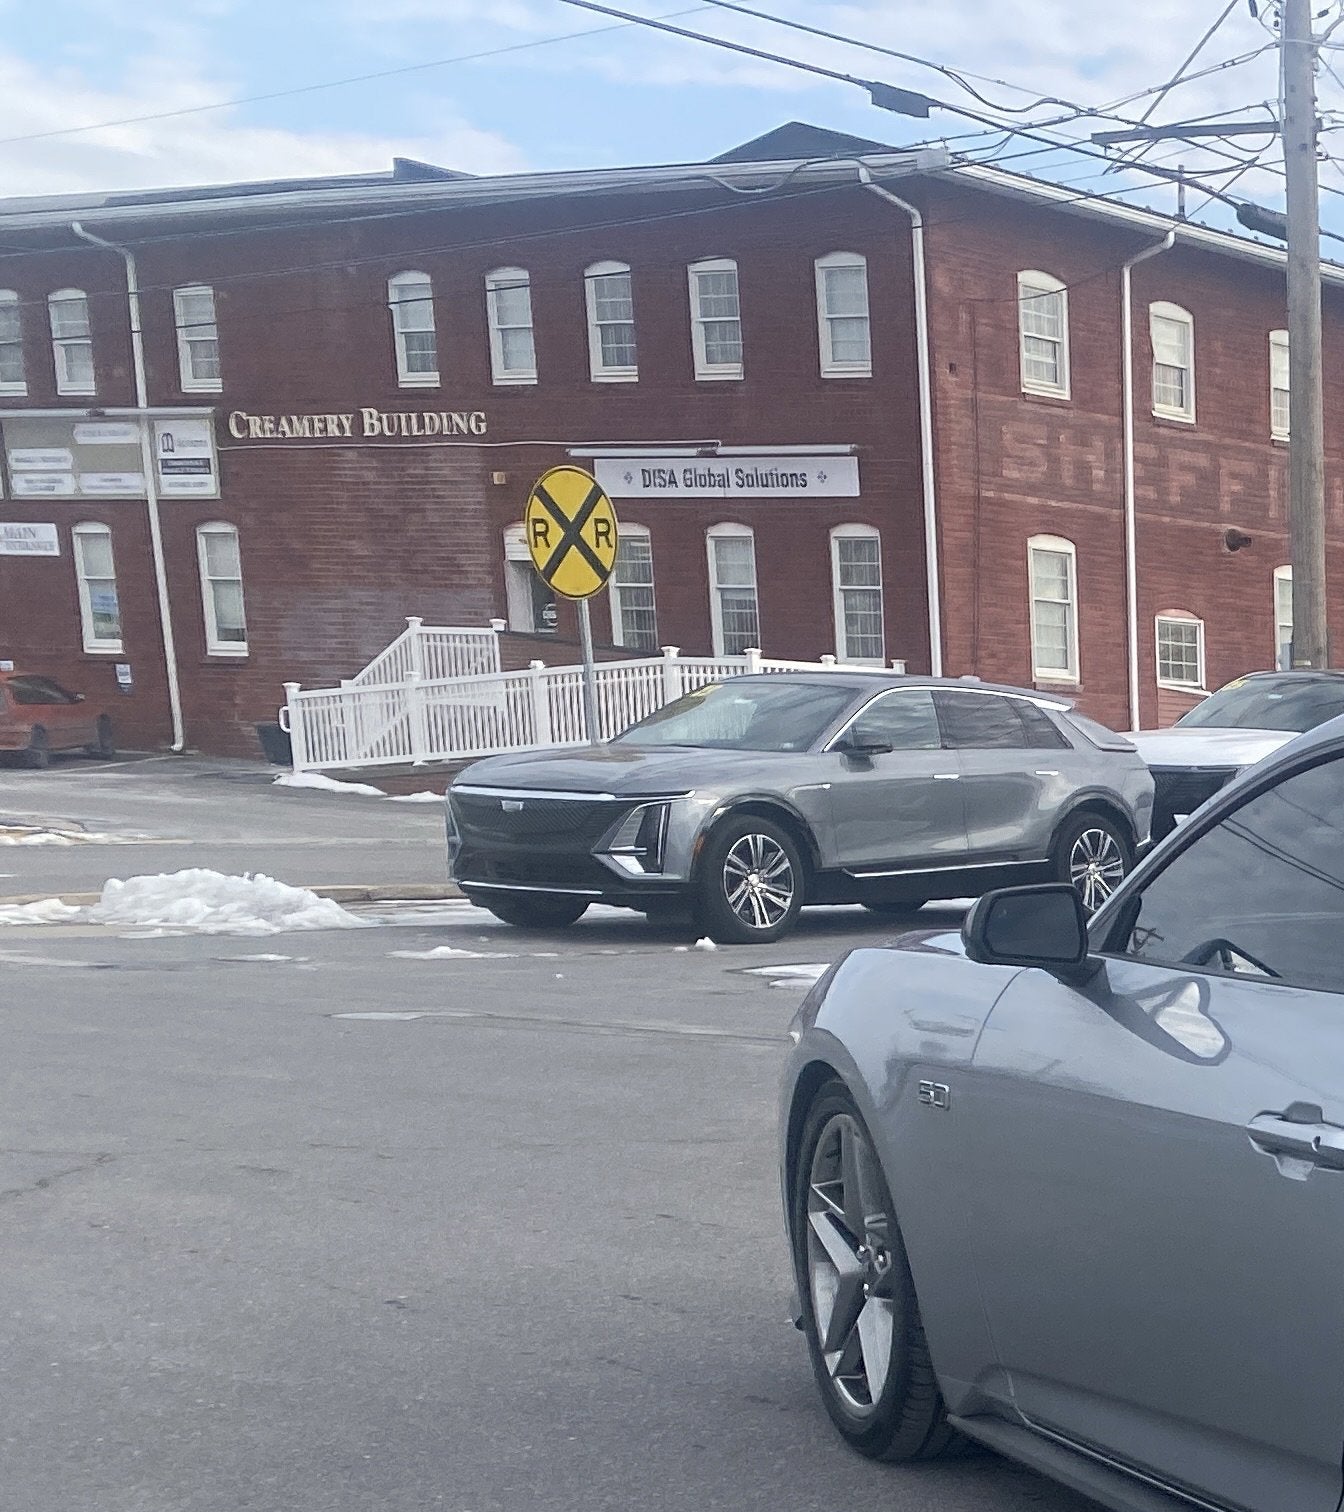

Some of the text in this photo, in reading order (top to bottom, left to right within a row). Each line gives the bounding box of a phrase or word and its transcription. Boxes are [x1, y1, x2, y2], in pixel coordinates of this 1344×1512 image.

[228, 407, 488, 439] CREAMERY BUILDING
[641, 467, 808, 488] DISA Global Solutions
[532, 518, 613, 548] R R
